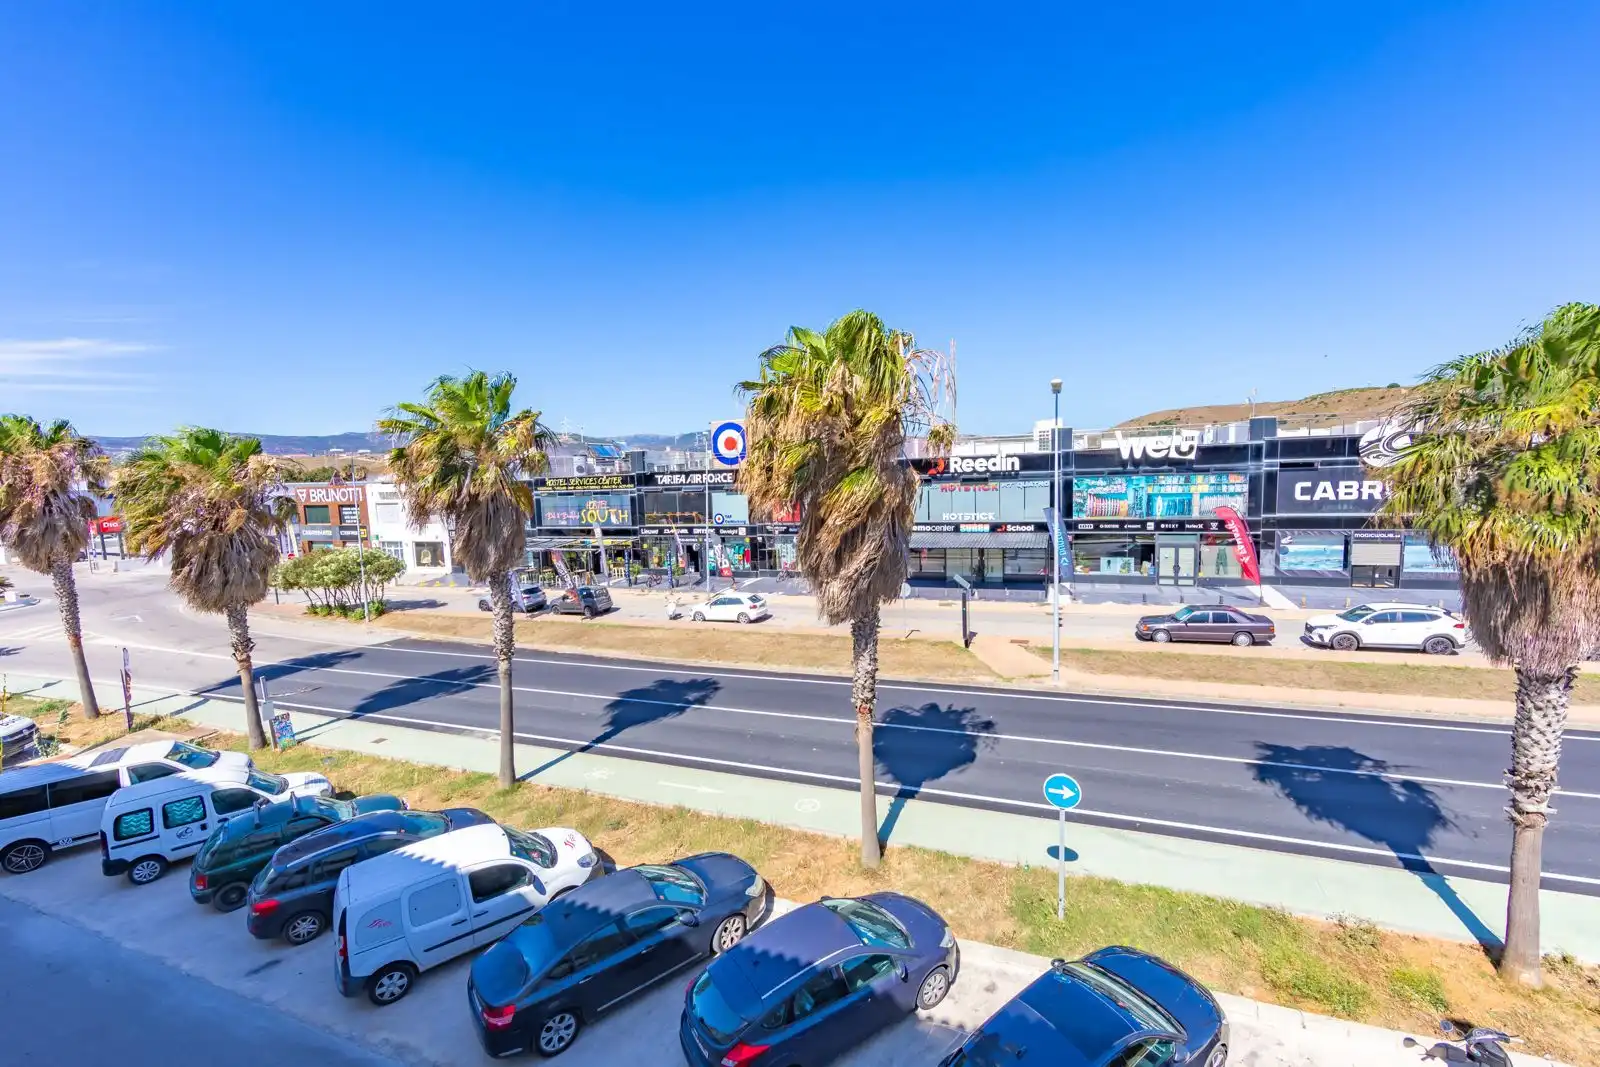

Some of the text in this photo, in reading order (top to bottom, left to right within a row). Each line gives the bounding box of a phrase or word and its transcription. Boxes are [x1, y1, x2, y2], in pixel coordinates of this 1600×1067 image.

[949, 454, 1020, 473] Reedin
[546, 477, 568, 486] HOSTEL
[655, 473, 733, 485] TARIFA AIR FORCE
[581, 509, 629, 524] SOUTH
[942, 512, 996, 521] HOTSTICK
[912, 524, 956, 532] emocenter
[1006, 524, 1035, 532] School
